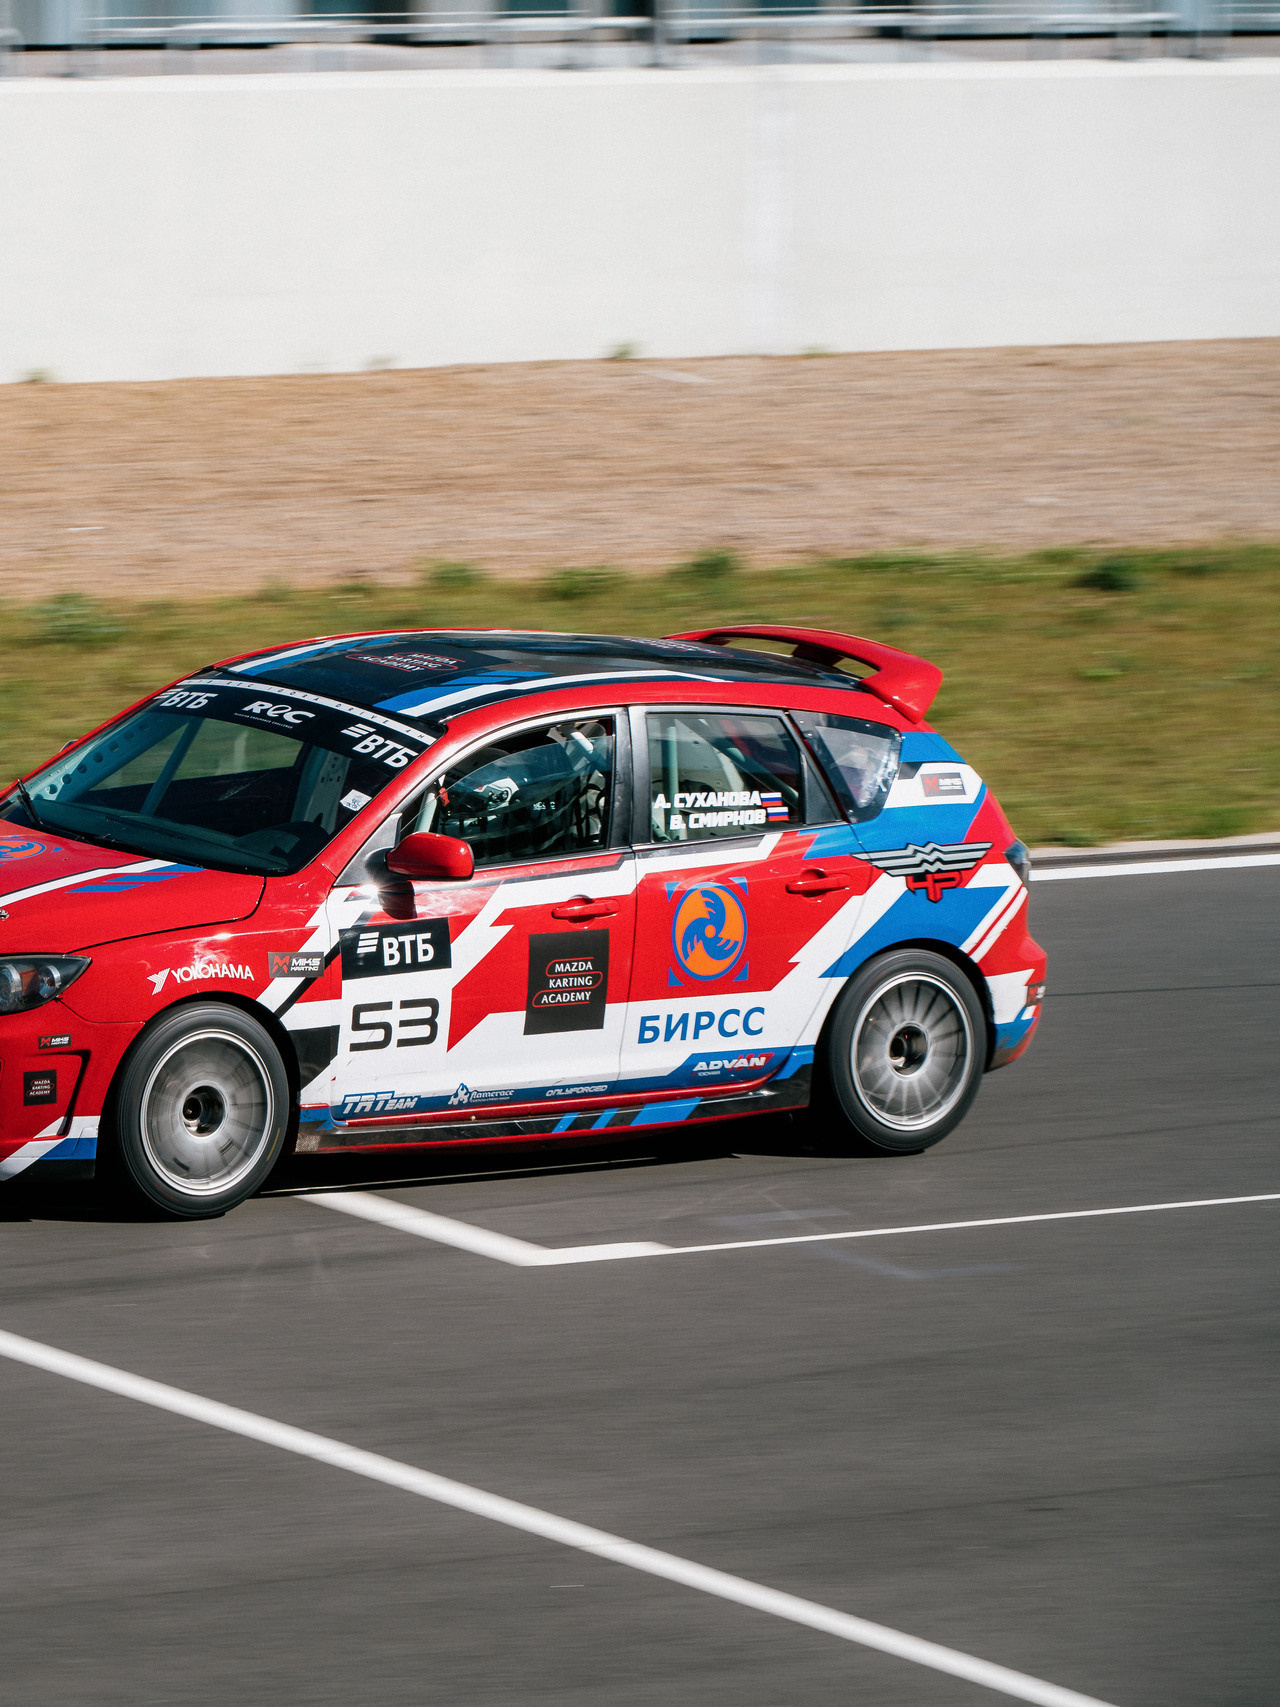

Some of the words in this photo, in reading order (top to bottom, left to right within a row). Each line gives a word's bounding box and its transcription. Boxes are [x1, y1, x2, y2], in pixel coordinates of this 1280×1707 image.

[160, 691, 219, 709] ВТБ
[268, 686, 320, 701] IGORA
[335, 703, 389, 724] DRIVE
[352, 734, 419, 768] ВТБ
[653, 793, 672, 809] А.
[673, 790, 762, 808] СУХАНОВА
[669, 814, 686, 830] В.
[688, 808, 766, 829] СМИРНОВ
[382, 932, 435, 967] ВТБ
[291, 957, 322, 966] MIKS
[554, 961, 593, 973] MAZDA
[171, 963, 255, 984] YOKOHAMA
[549, 976, 593, 989] KARTING
[541, 991, 592, 1004] ACADEMY
[349, 997, 440, 1052] 53
[637, 1006, 765, 1044] БИРСС
[692, 1057, 766, 1071] ADVAN
